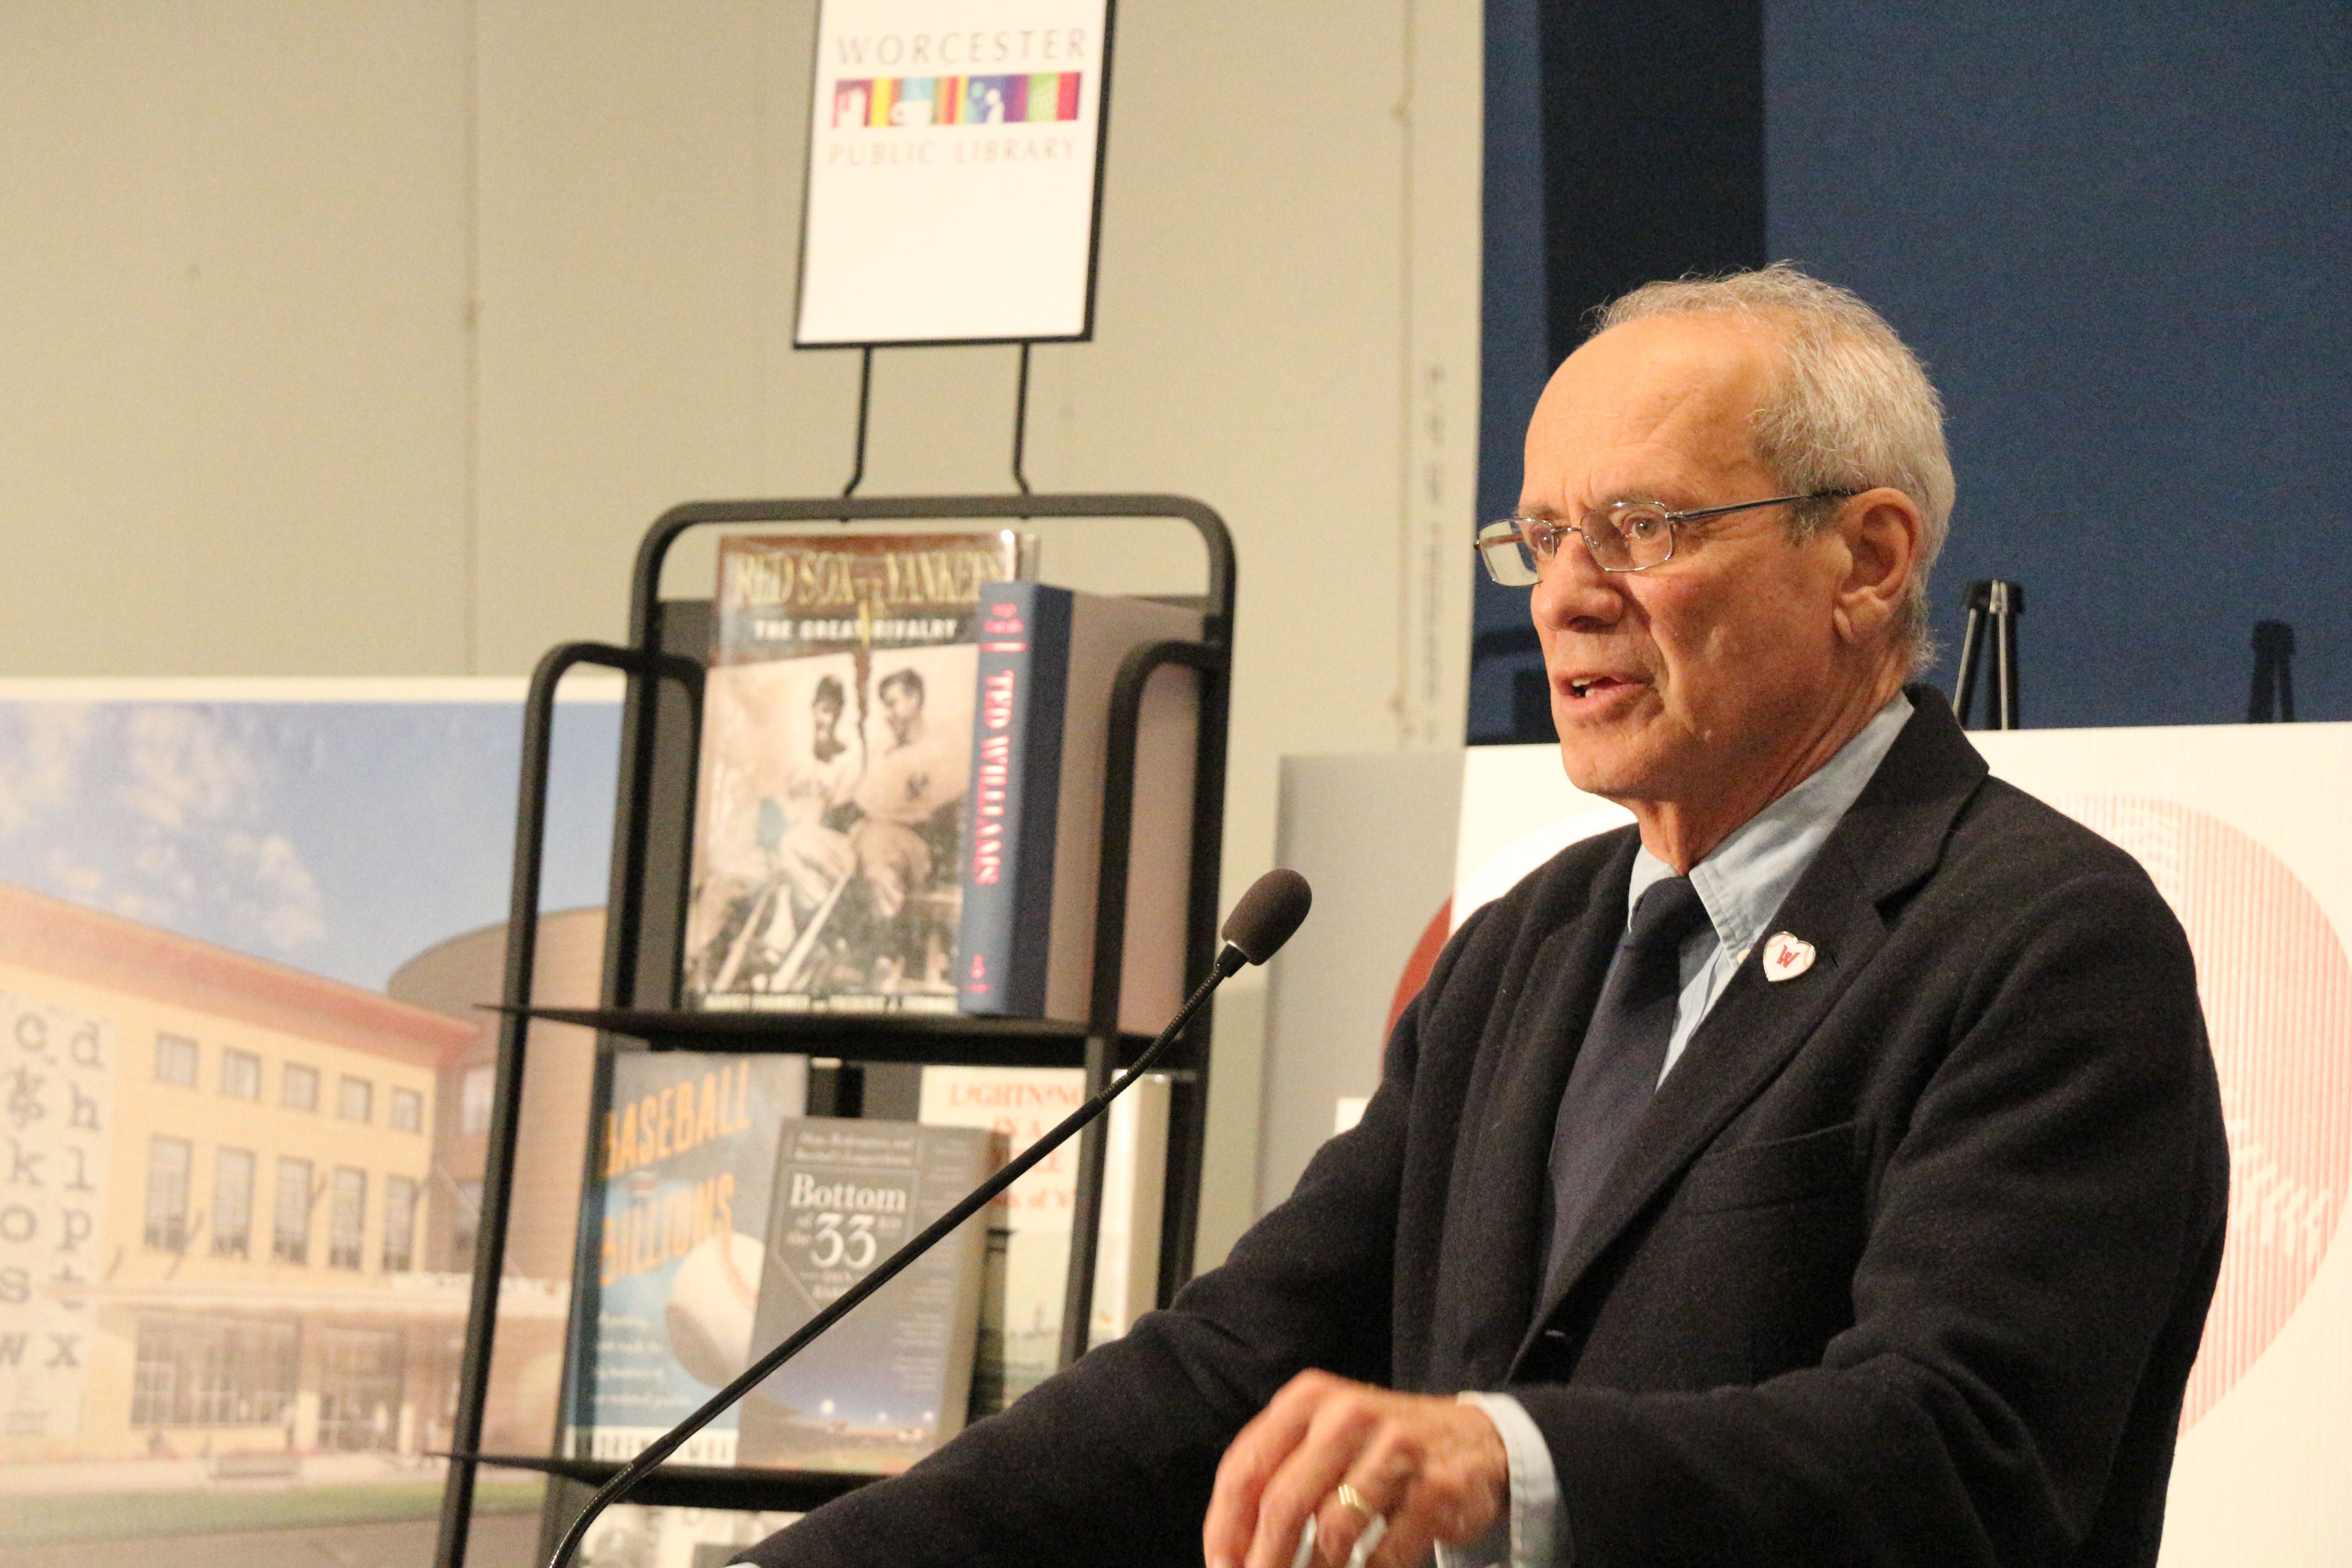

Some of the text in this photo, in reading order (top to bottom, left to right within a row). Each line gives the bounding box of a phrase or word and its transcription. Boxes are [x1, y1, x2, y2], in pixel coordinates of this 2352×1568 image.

[836, 27, 1087, 66] WORCESTER
[828, 137, 1077, 167] PUBLIC LIBRARY
[798, 551, 856, 605] SOX
[753, 617, 958, 640] THE GREAT RIVALRY
[983, 669, 1014, 729] TED
[973, 734, 1010, 886] WILLIAMS
[1776, 944, 1801, 969] W
[13, 1011, 105, 1071] c d
[68, 1079, 101, 1131] h
[7, 1135, 46, 1188] k
[789, 1173, 907, 1213] Bottom
[0, 1204, 93, 1251] o p
[0, 1267, 31, 1303] s
[45, 1333, 82, 1367] x
